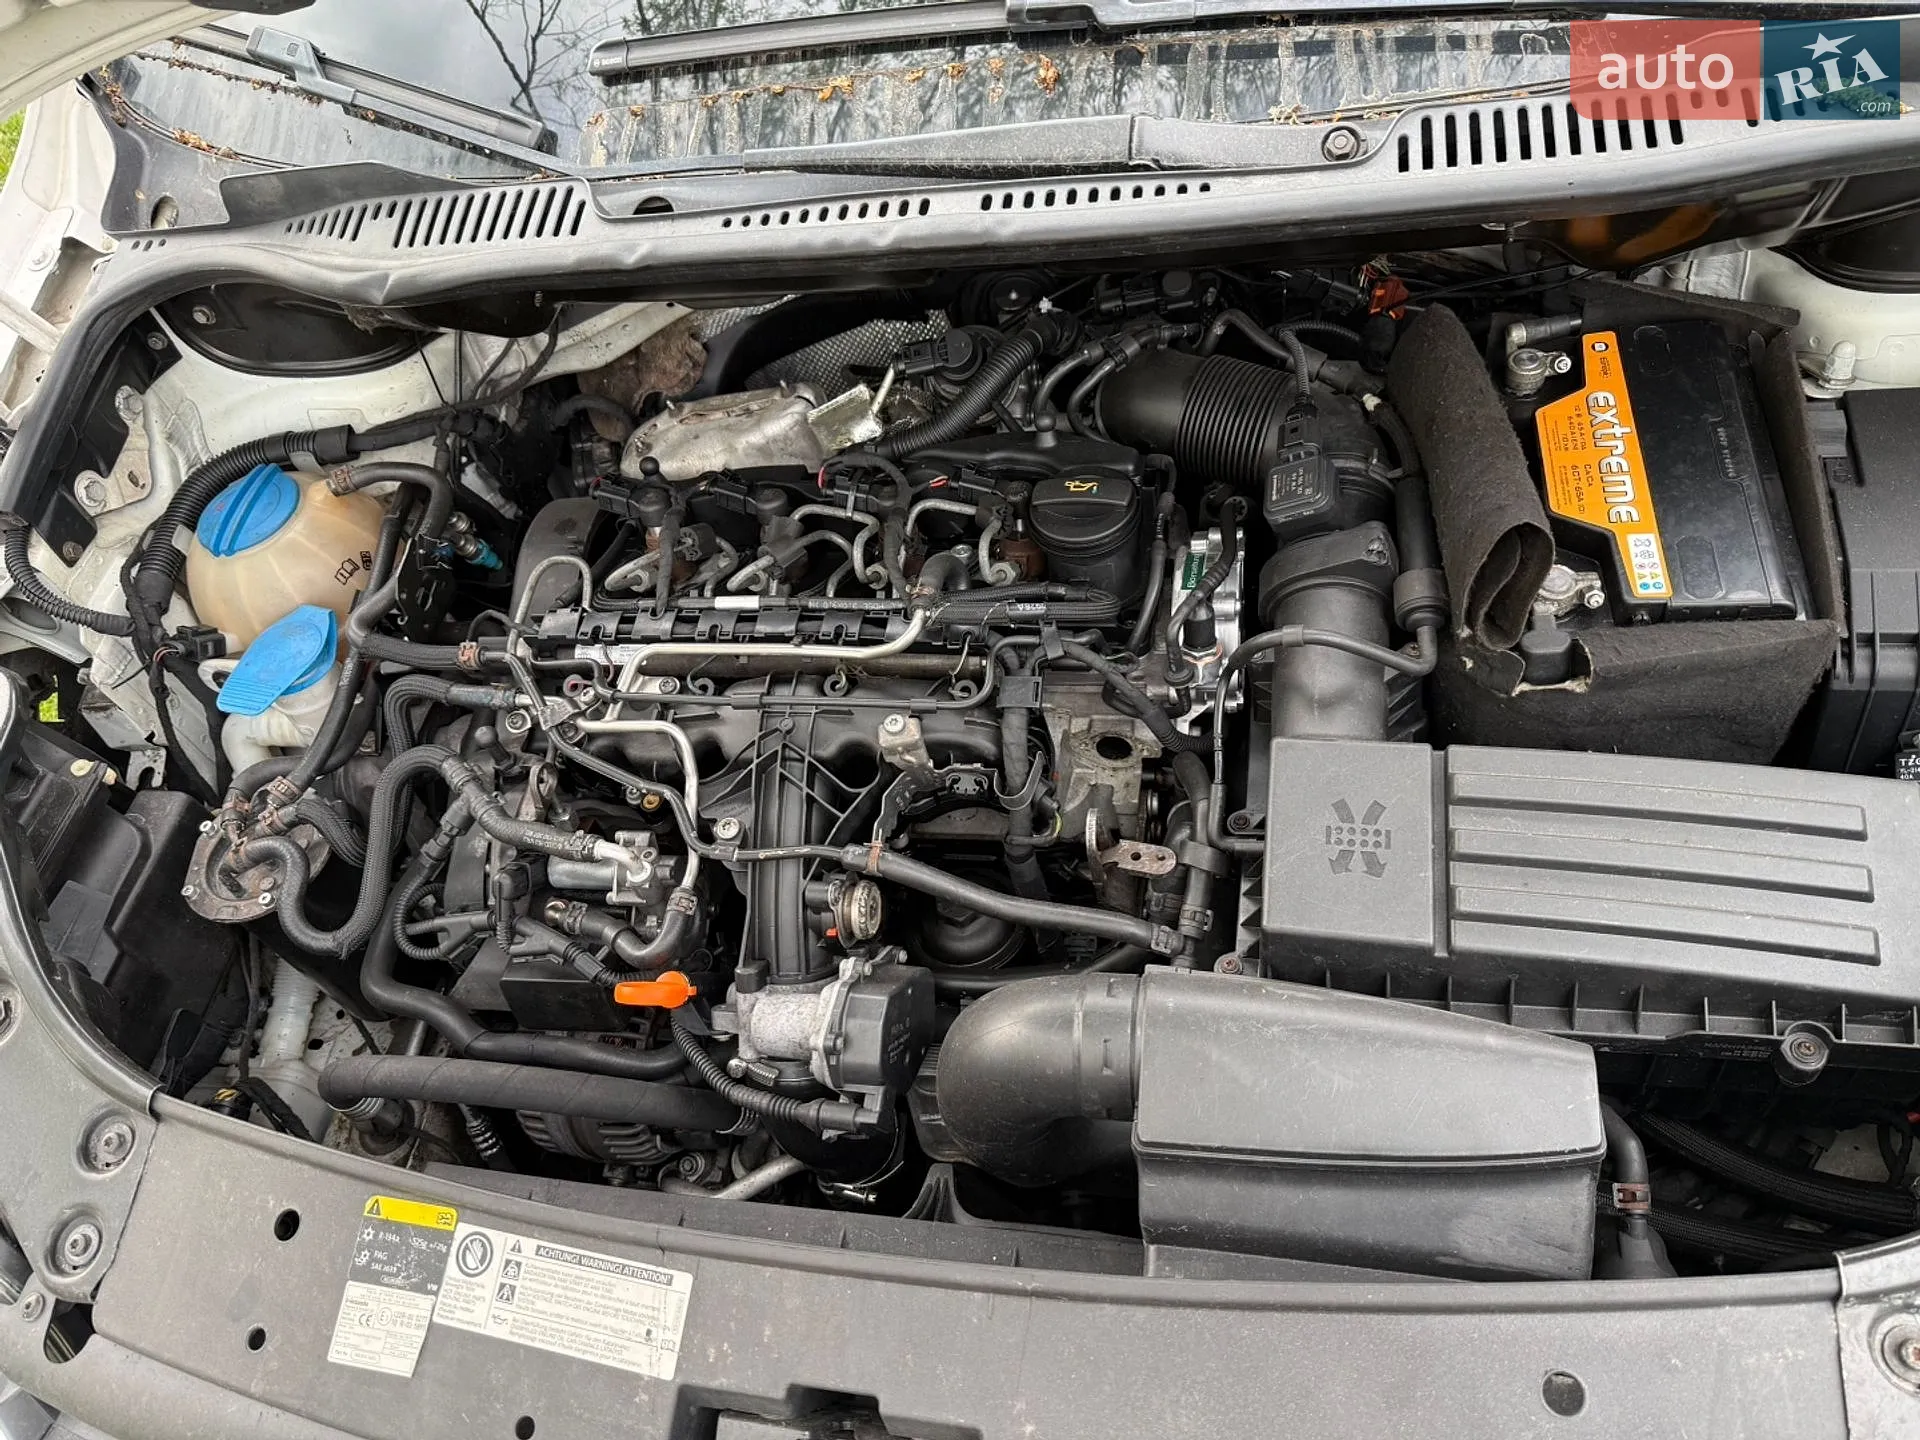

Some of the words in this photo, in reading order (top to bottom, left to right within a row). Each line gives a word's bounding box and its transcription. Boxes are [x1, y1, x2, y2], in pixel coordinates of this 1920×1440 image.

[539, 1246, 581, 1264] ACHTUNG!
[580, 1255, 623, 1275] WARNING!
[622, 1265, 672, 1285] ATTENTION!
